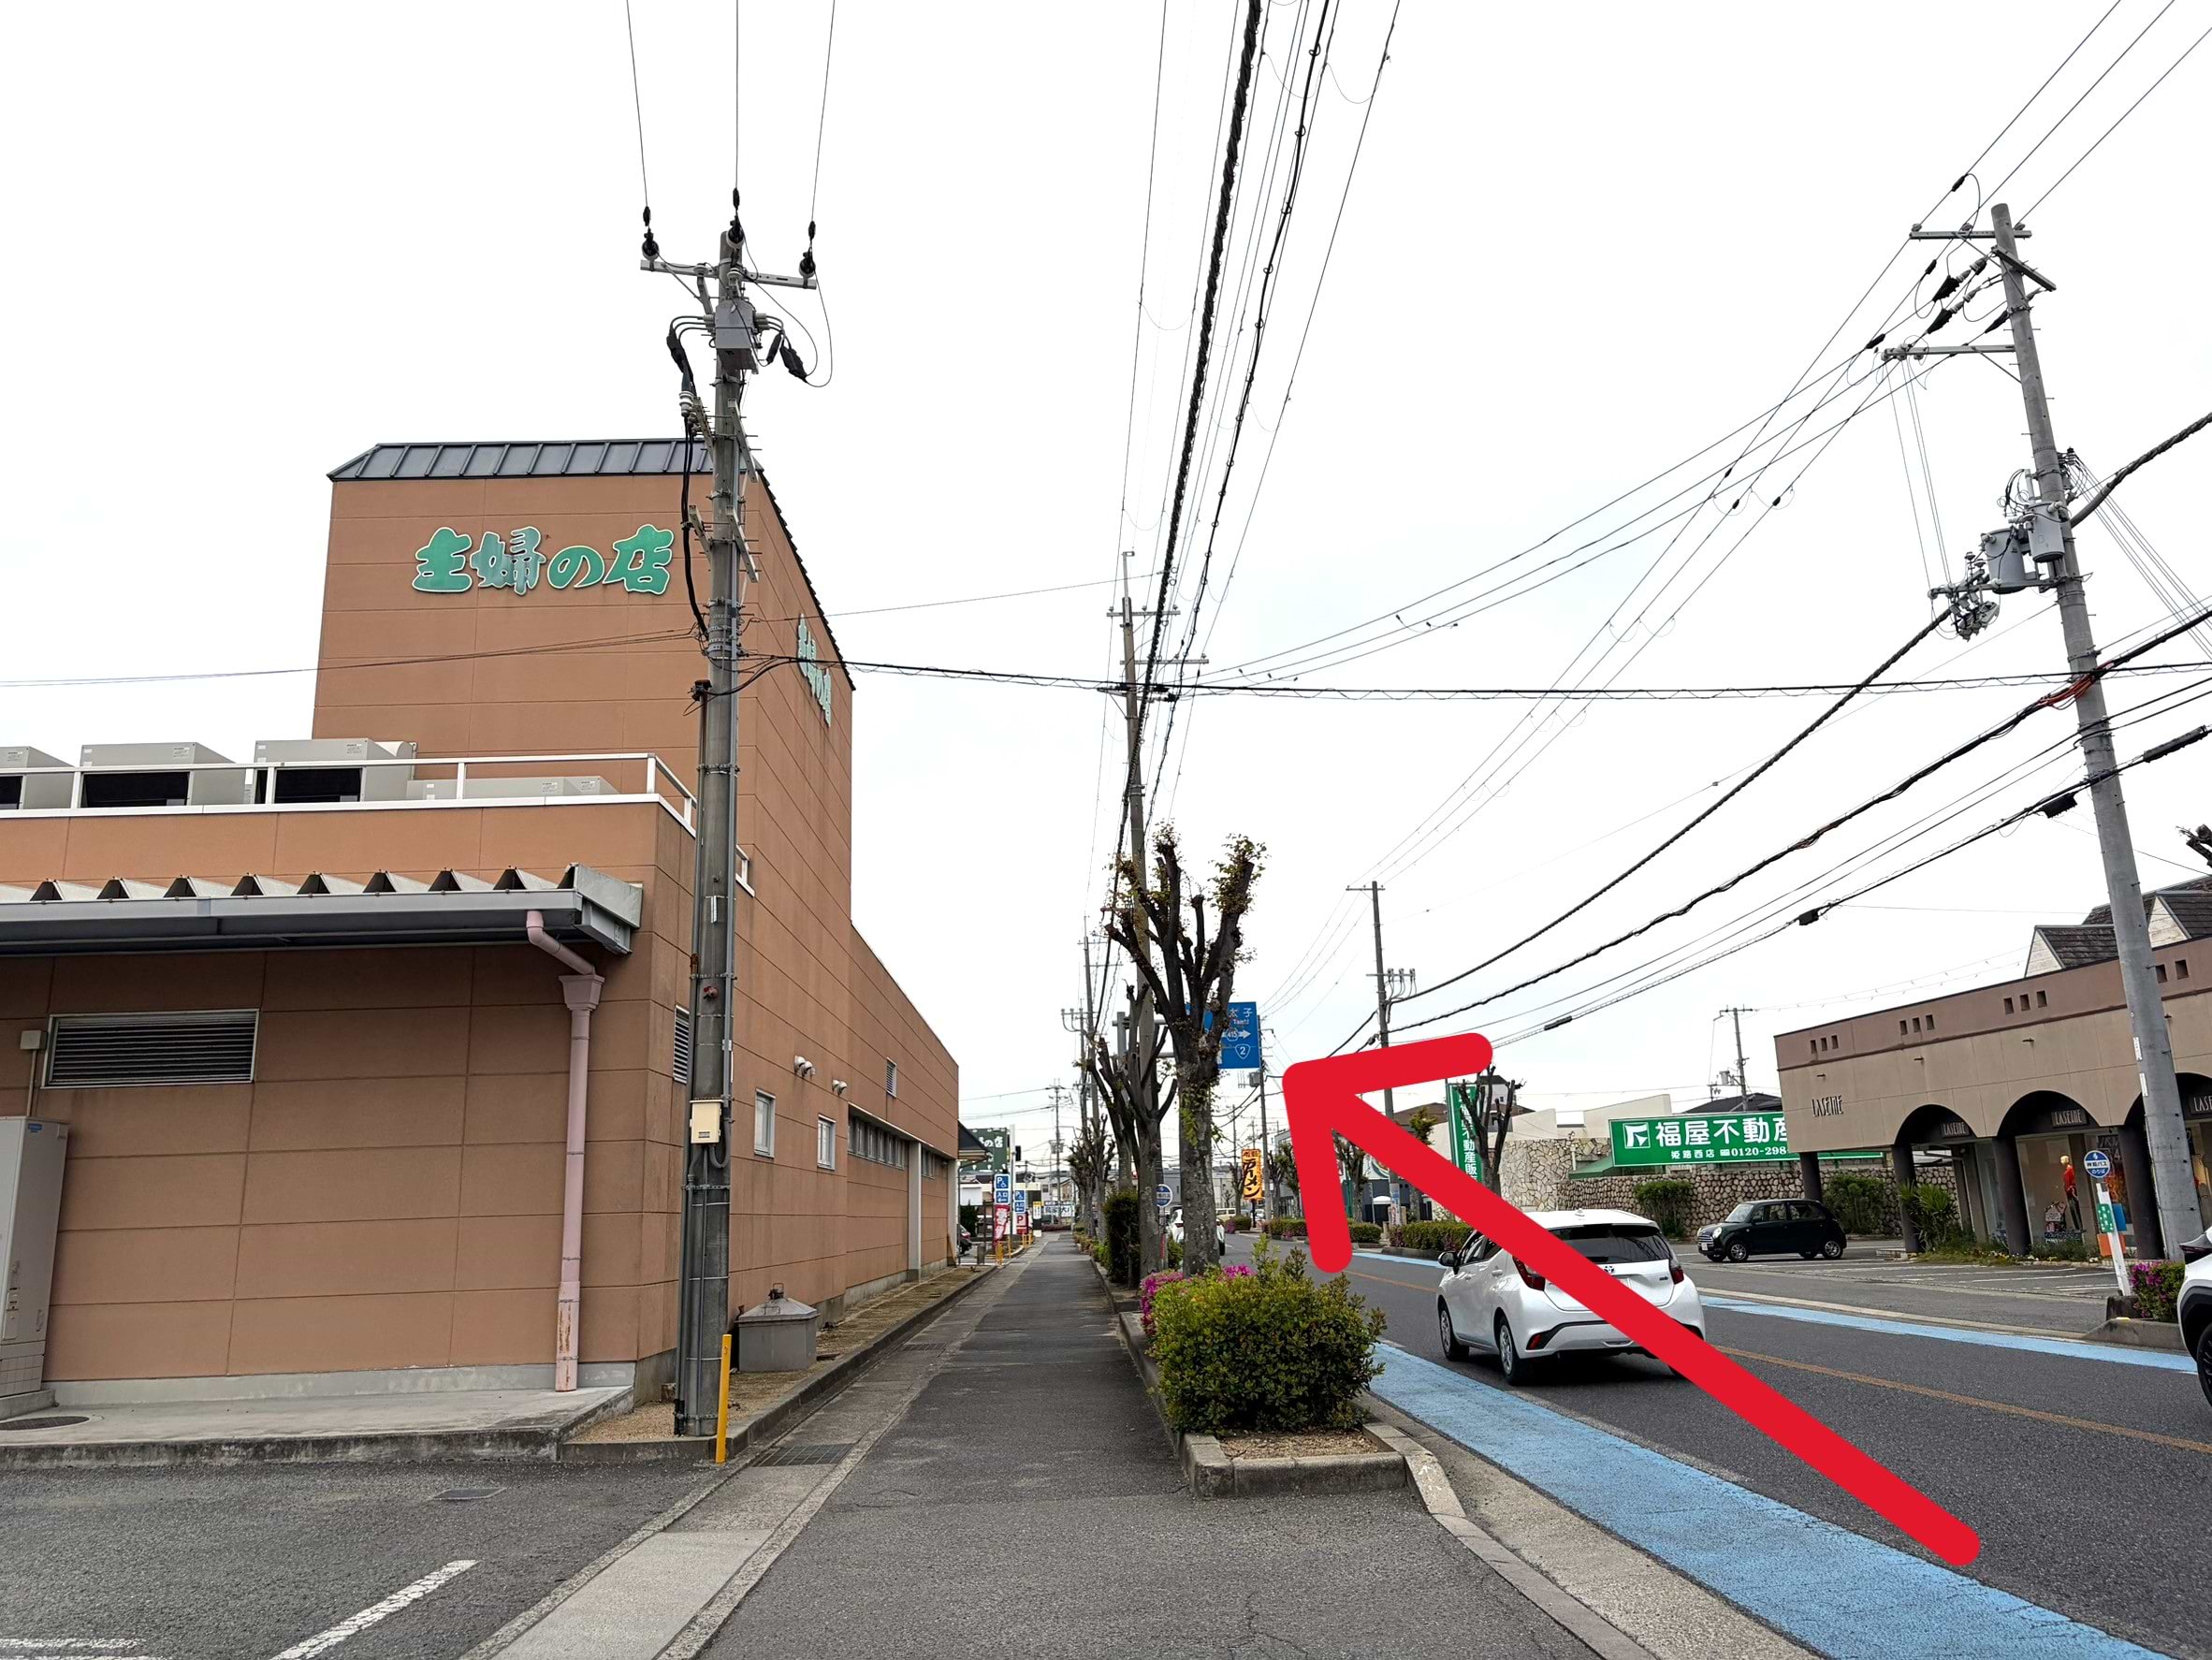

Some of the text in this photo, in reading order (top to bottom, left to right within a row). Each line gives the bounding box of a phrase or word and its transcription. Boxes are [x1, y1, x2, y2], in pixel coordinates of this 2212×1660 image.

[412, 524, 674, 595] 主婦の店
[1240, 1046, 1246, 1056] 2
[1671, 1149, 1714, 1159] 姫路西店
[1017, 1216, 1024, 1224] P
